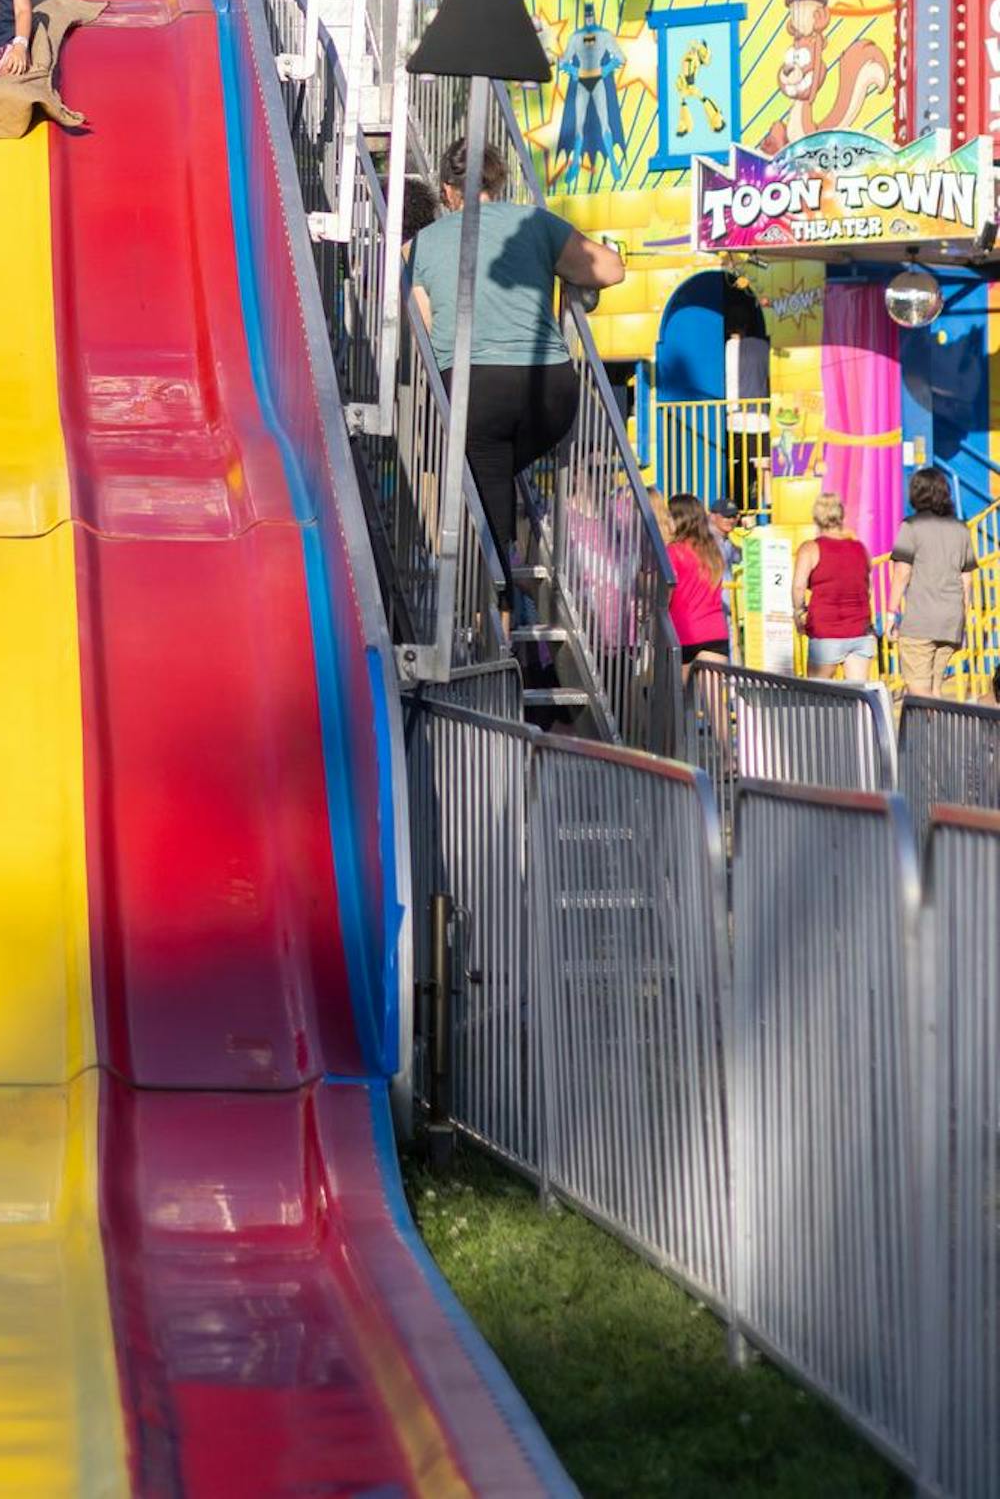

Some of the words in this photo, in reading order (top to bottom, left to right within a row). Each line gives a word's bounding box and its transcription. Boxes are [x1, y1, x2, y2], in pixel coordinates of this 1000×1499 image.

[702, 176, 823, 241] TOON
[836, 171, 979, 228] TOWN
[790, 216, 884, 242] THEATER
[774, 573, 783, 587] 2
